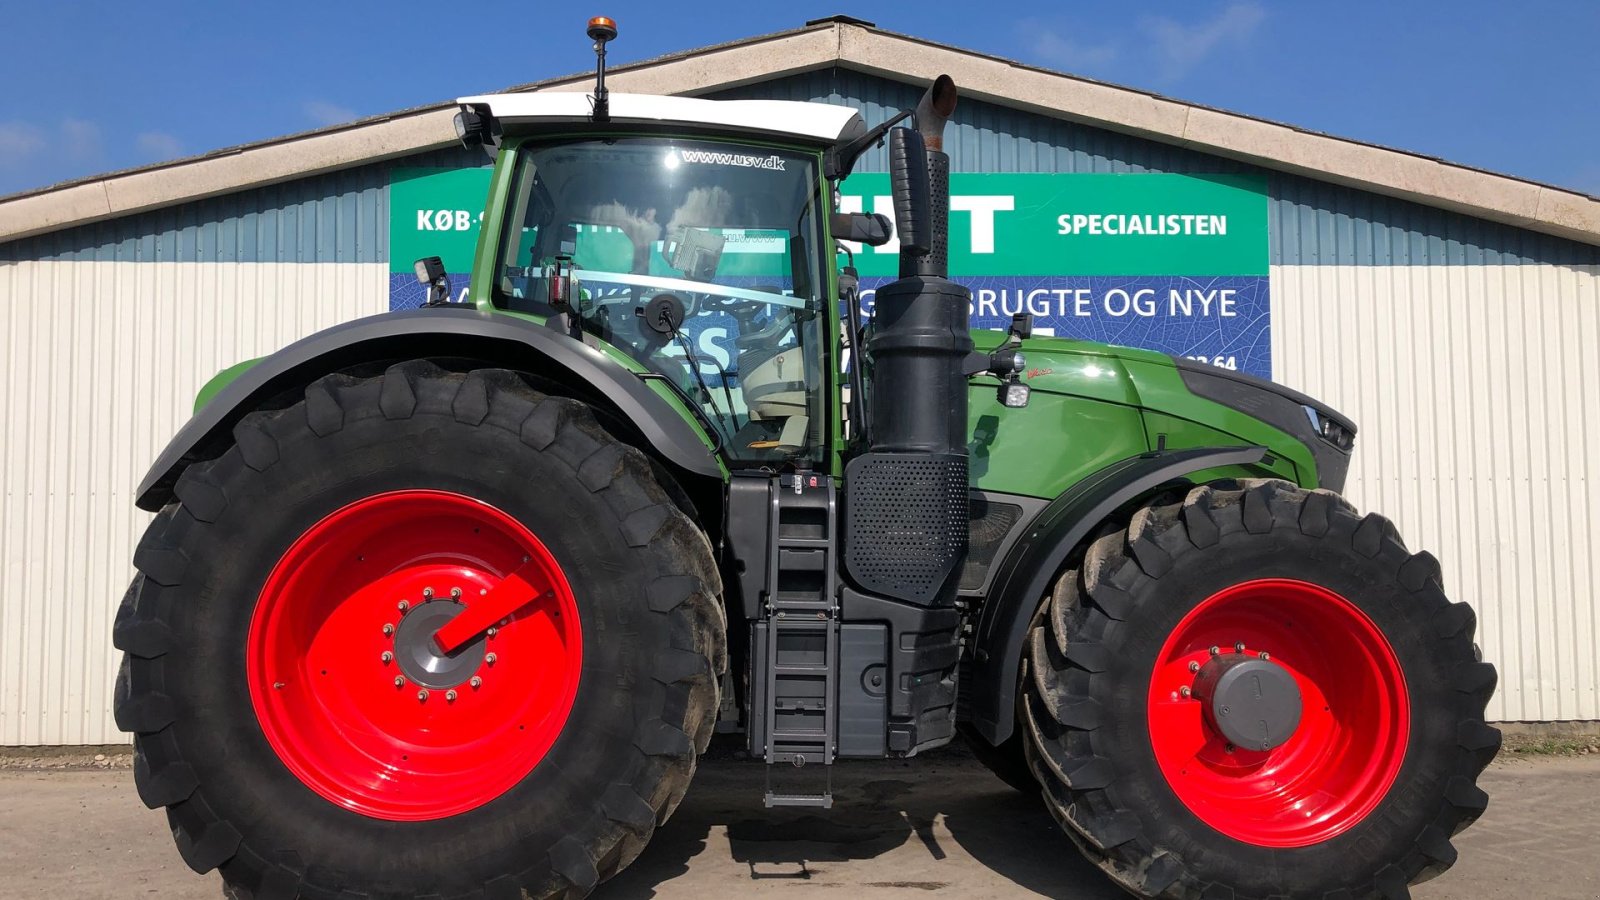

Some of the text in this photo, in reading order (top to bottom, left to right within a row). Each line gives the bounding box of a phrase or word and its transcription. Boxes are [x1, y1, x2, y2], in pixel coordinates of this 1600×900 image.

[682, 150, 785, 171] www.usv.dk
[1057, 214, 1227, 235] SPECIALISTEN
[1104, 288, 1156, 317] OG
[1170, 289, 1236, 317] NYE
